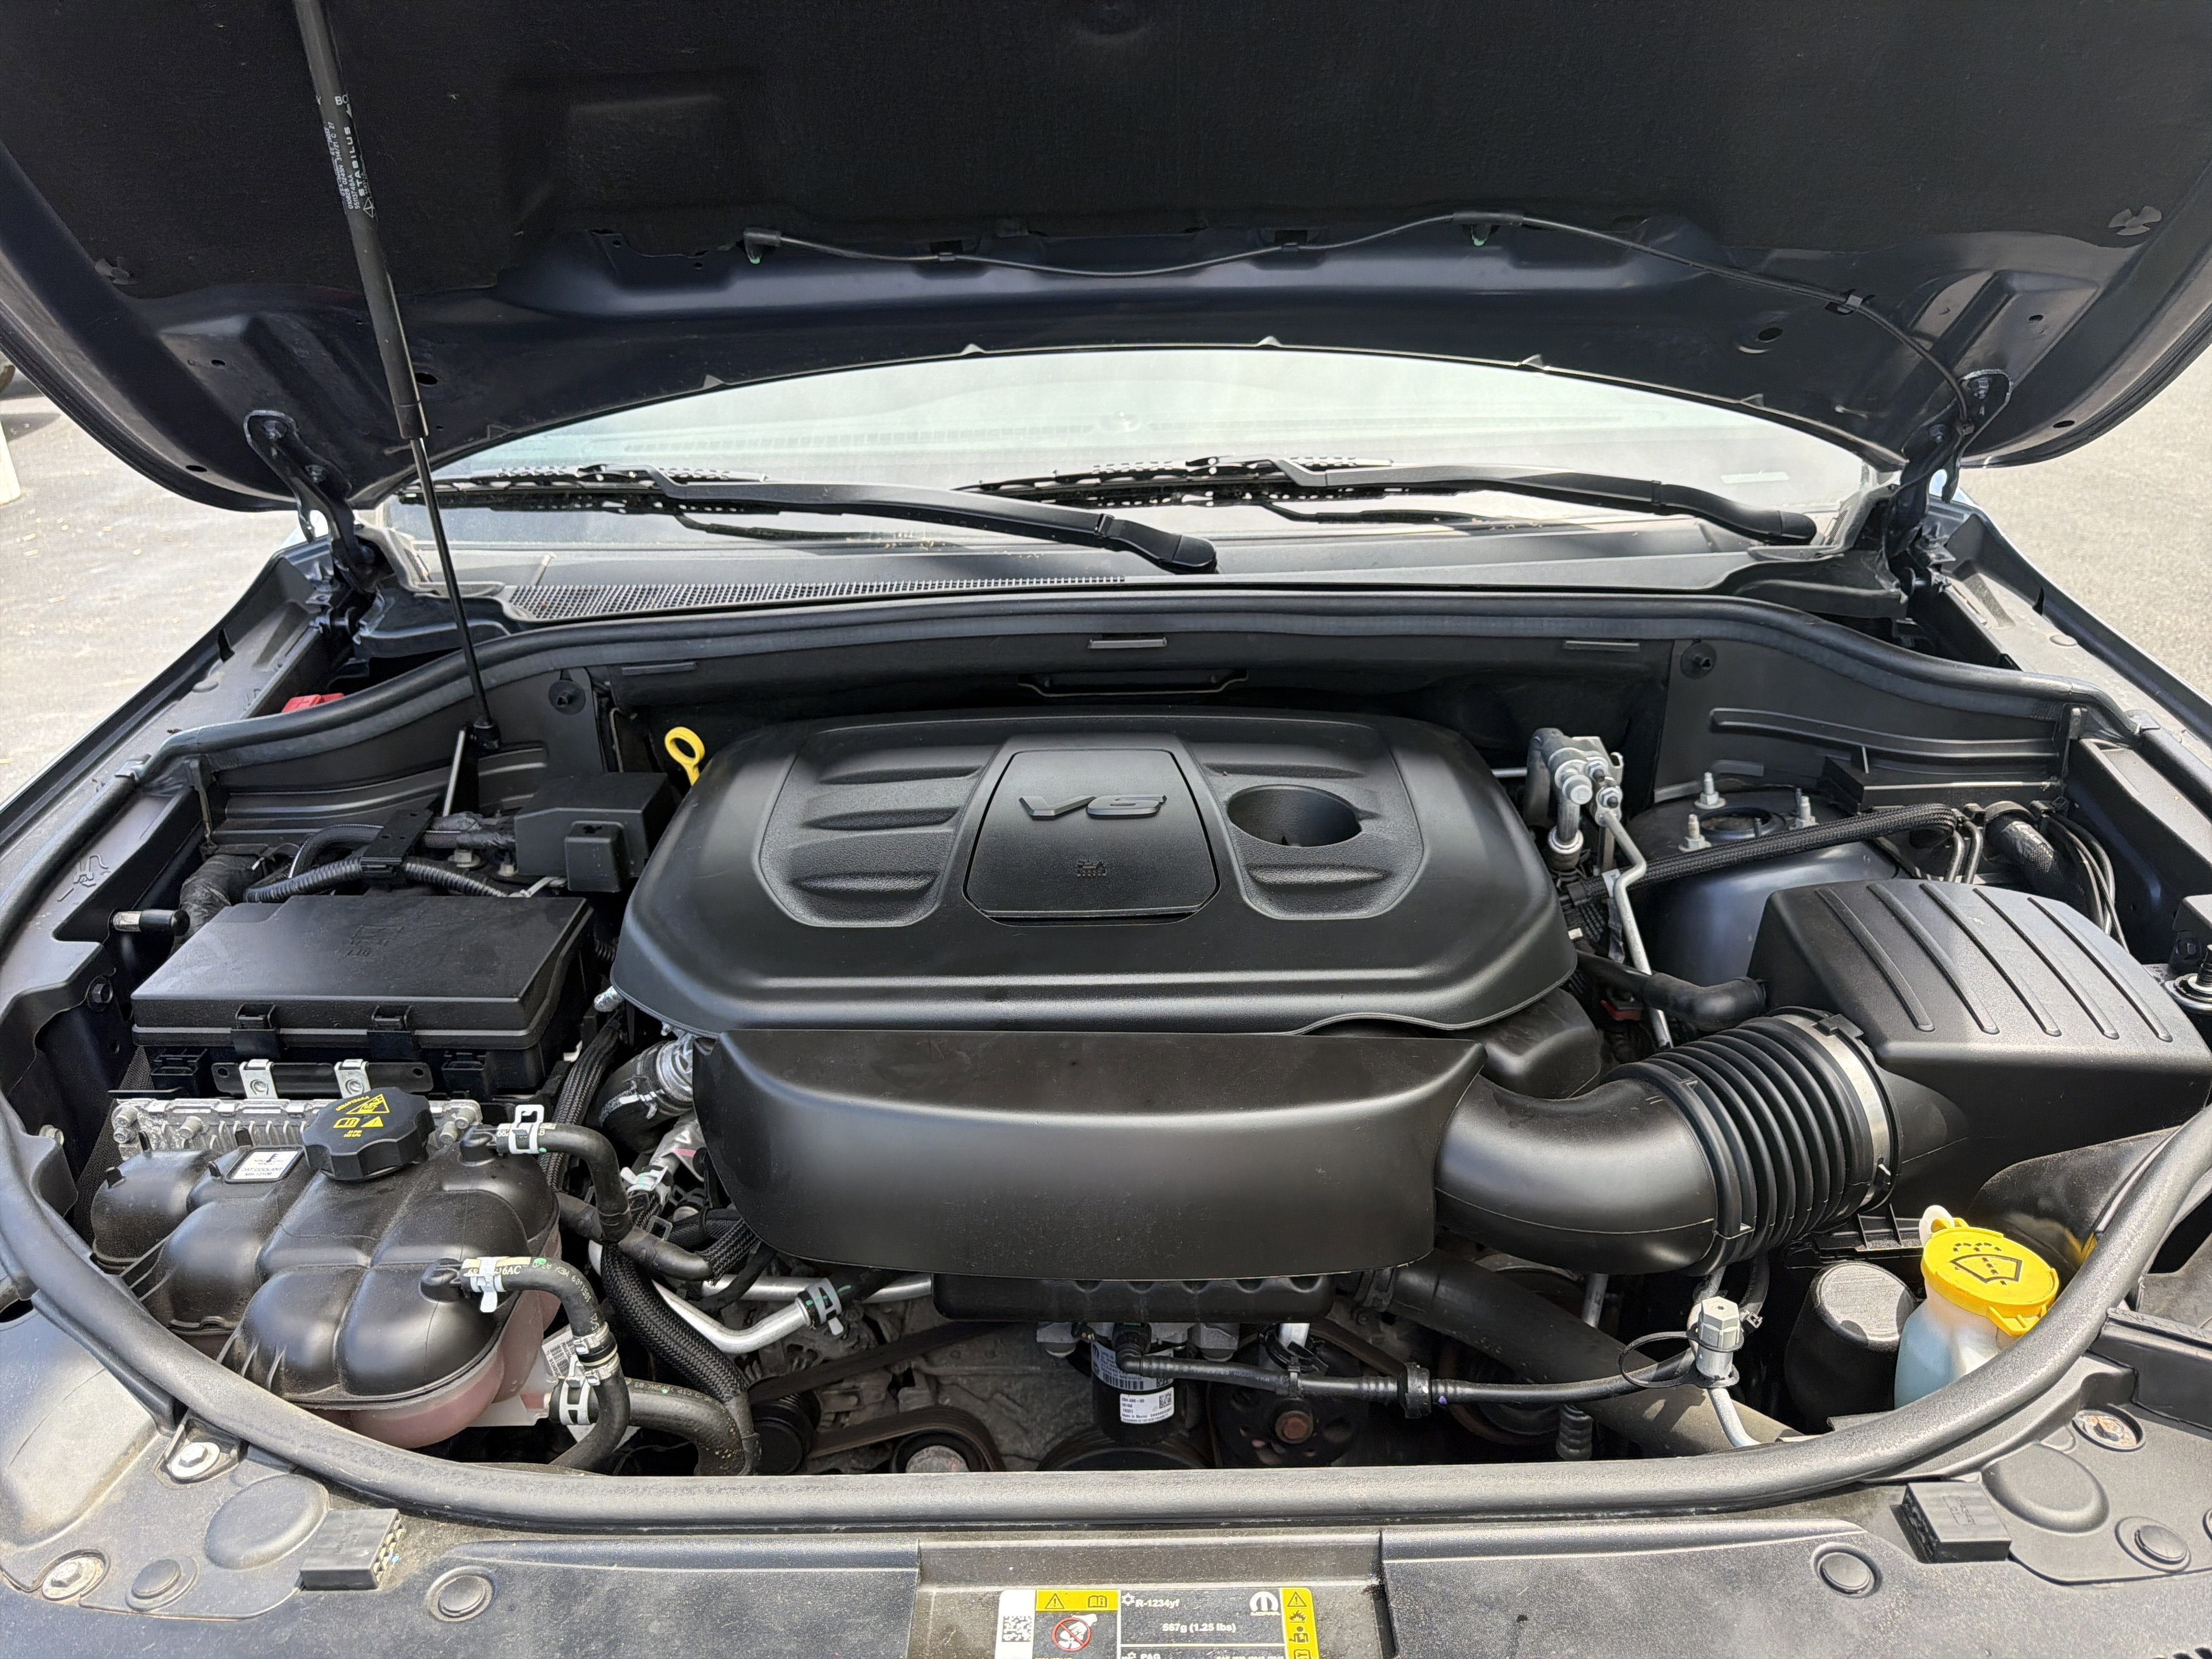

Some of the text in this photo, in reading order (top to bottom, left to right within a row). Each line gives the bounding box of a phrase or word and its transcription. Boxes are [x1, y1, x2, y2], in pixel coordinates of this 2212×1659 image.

[343, 126, 366, 197] STABILUS
[1019, 794, 1168, 821] V6
[1135, 1599, 1180, 1607] R-1234yf
[1162, 1622, 1236, 1633] 567g (1.25 lbs)
